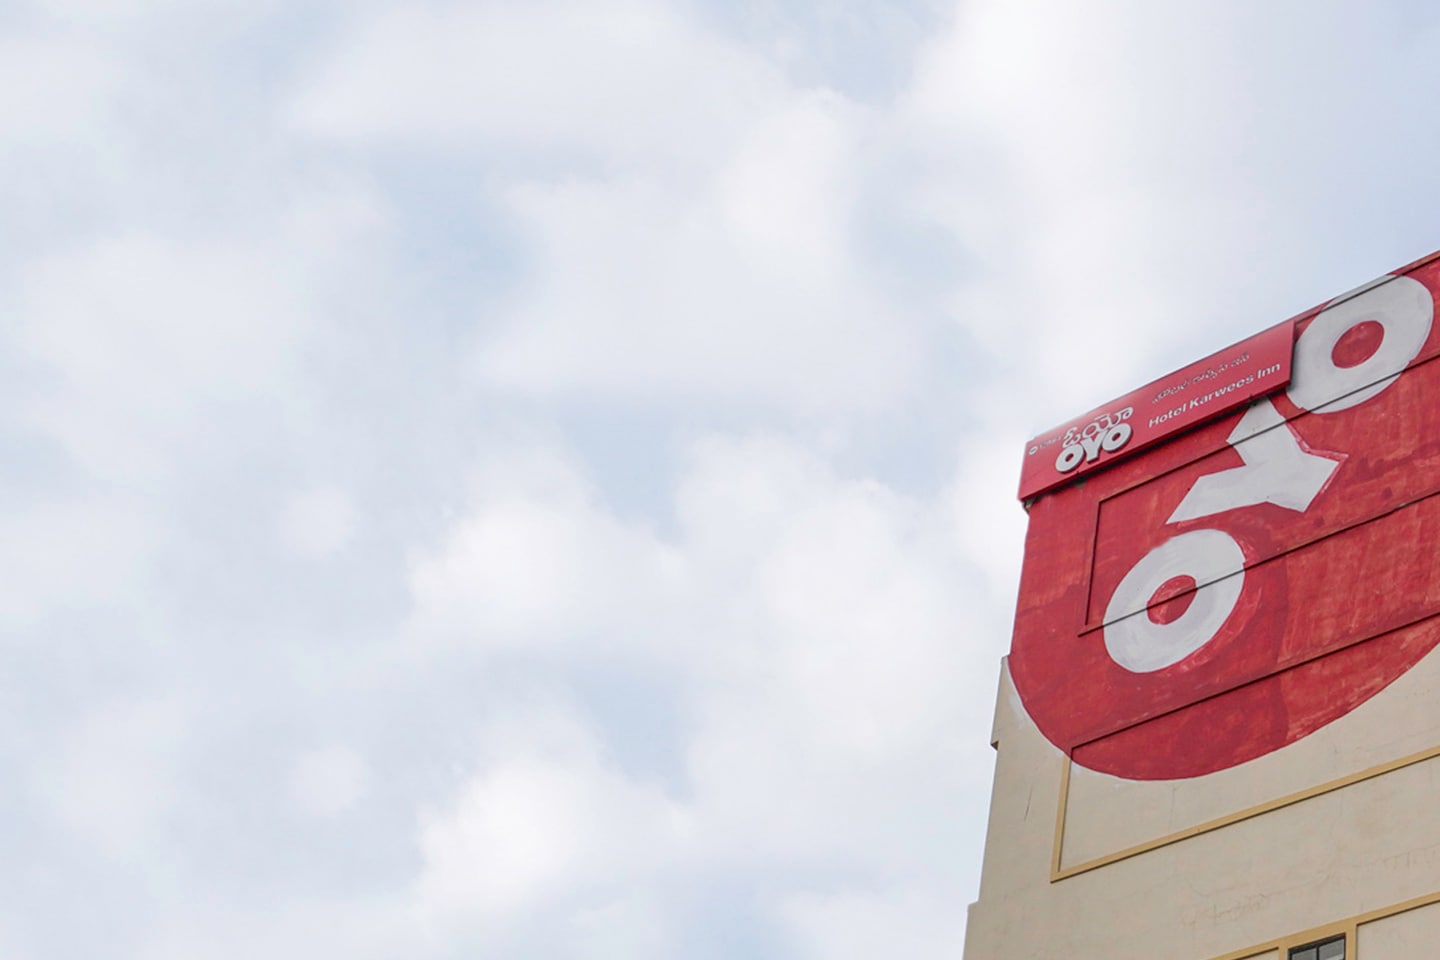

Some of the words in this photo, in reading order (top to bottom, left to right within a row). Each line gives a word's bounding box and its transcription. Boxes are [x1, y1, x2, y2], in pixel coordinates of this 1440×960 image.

[1148, 403, 1187, 428] Hotel
[1189, 374, 1254, 410] Karwees
[1257, 362, 1281, 380] Inn
[1055, 422, 1132, 474] OYO
